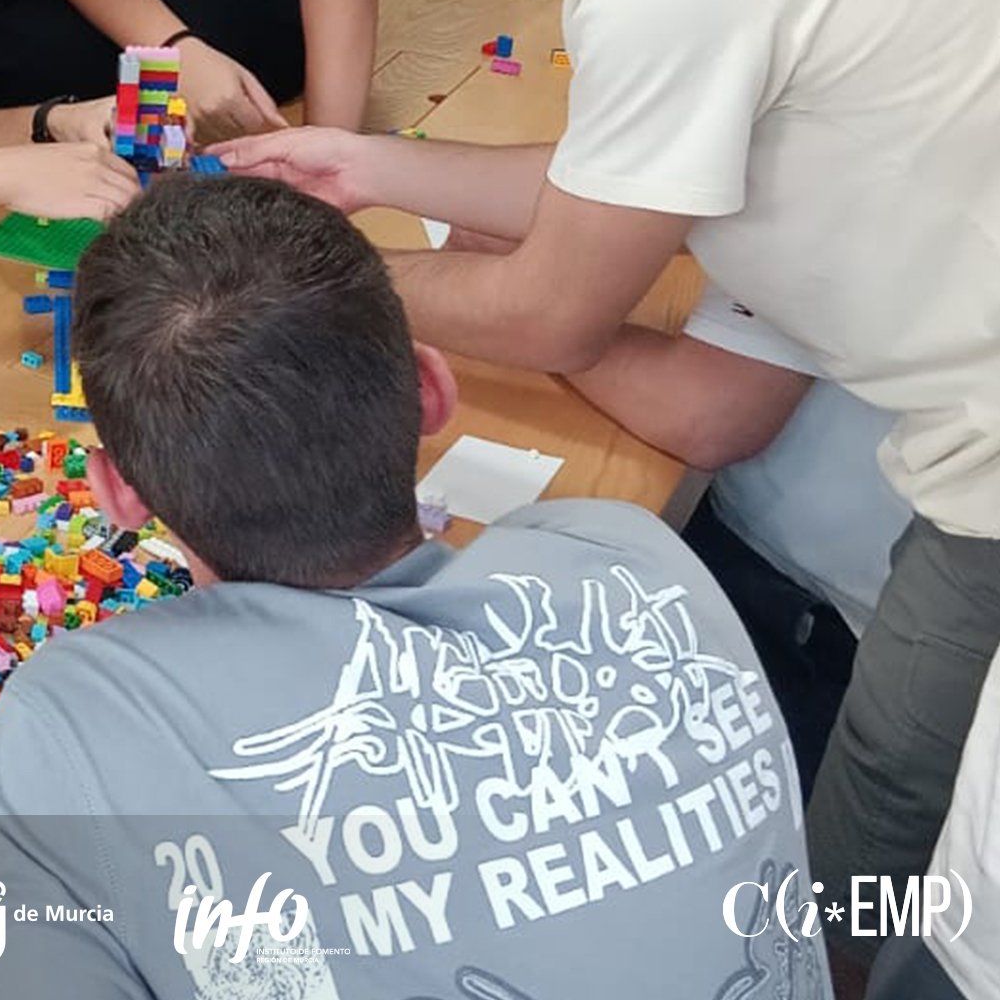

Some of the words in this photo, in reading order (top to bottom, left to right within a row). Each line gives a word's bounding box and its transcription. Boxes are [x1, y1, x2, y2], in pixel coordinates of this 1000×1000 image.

[154, 834, 224, 911] 20
[281, 795, 459, 885] YOU
[684, 668, 773, 764] SEE
[340, 872, 453, 956] MY
[477, 750, 783, 930] REALITIES
